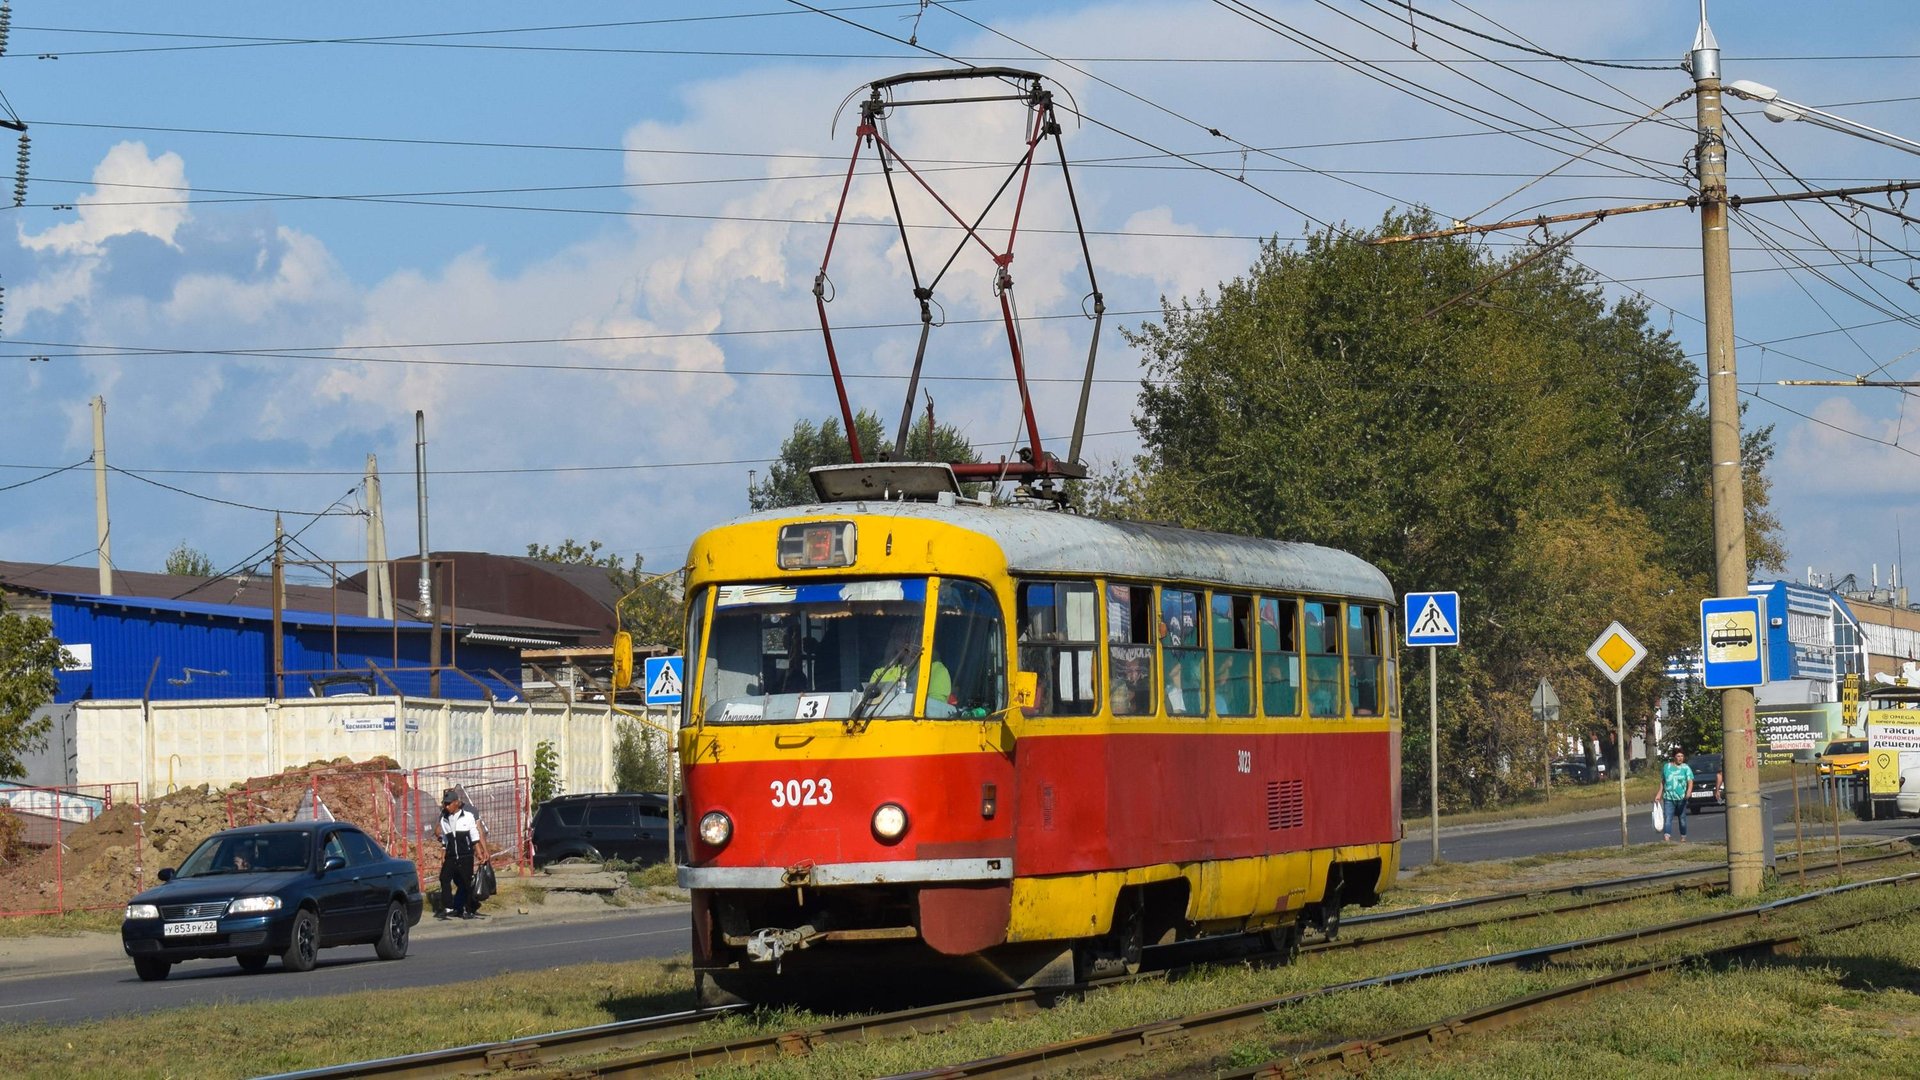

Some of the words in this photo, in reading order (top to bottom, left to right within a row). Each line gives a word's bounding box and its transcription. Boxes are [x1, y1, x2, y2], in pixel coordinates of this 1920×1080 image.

[803, 700, 819, 718] 3
[1883, 727, 1915, 735] такси
[1873, 740, 1920, 749] дешевл
[1238, 749, 1251, 774] 3023
[770, 778, 834, 808] 3023
